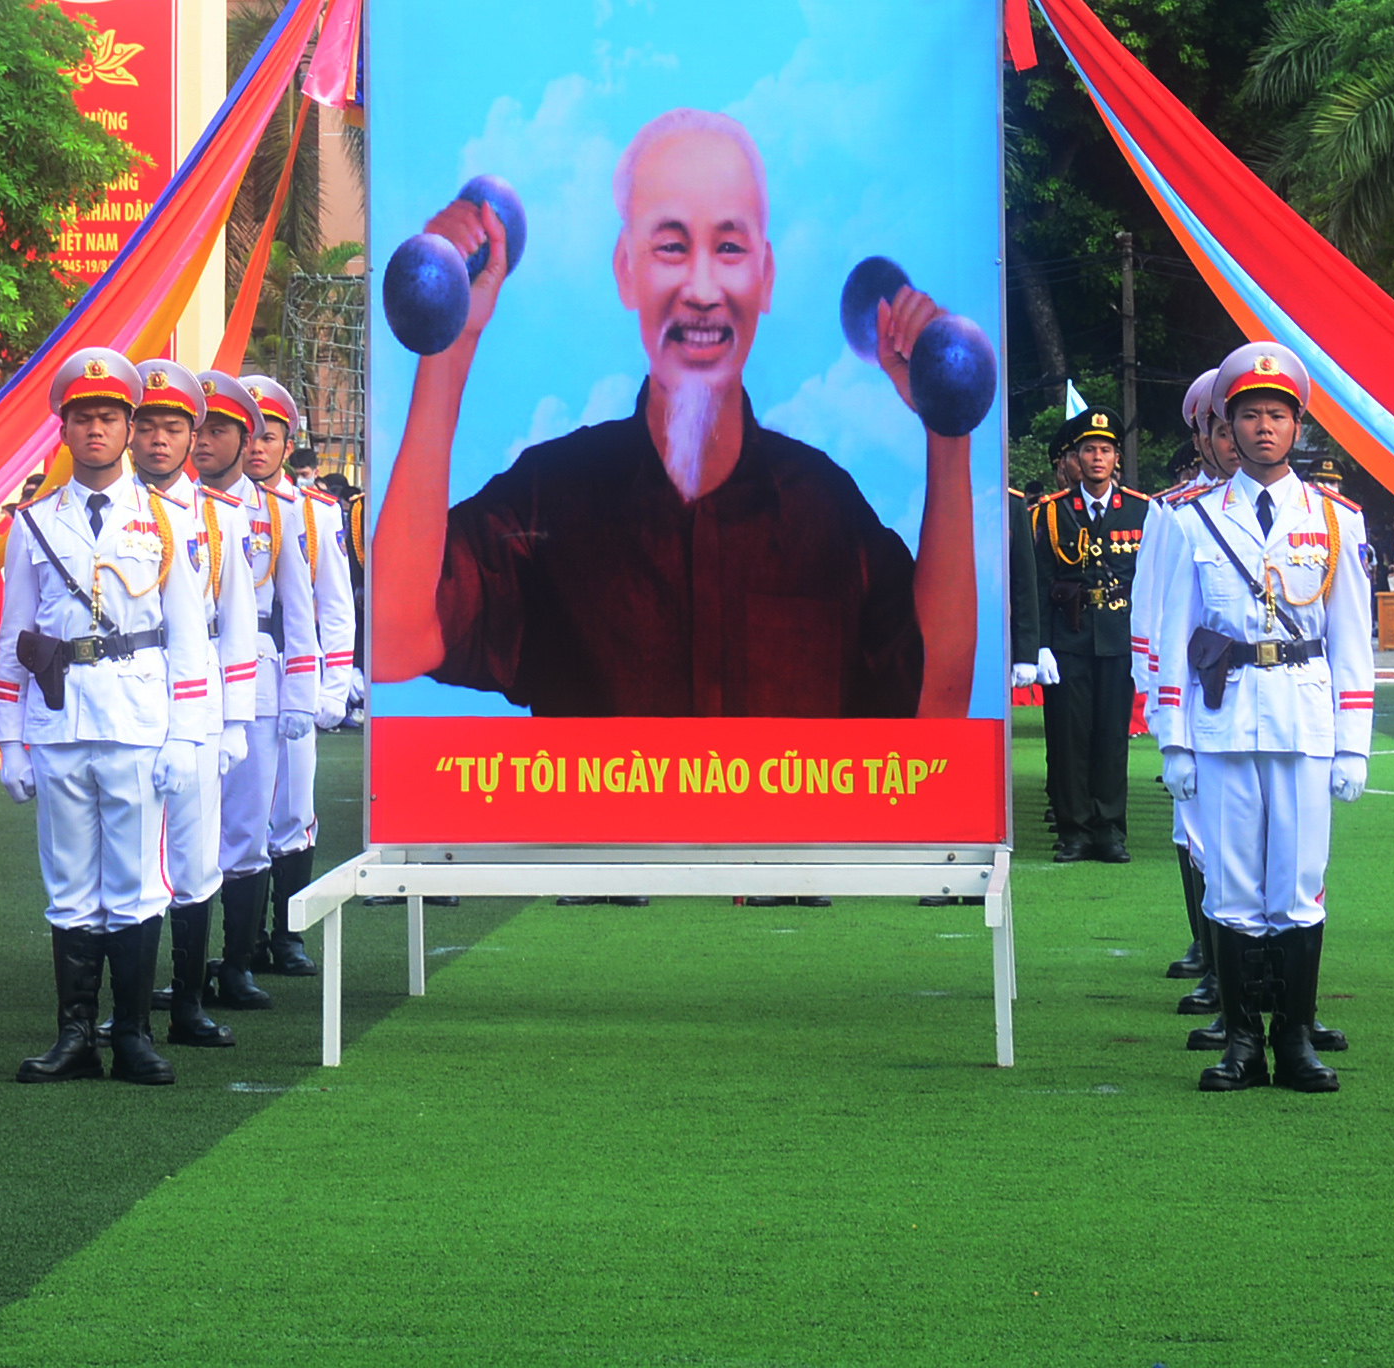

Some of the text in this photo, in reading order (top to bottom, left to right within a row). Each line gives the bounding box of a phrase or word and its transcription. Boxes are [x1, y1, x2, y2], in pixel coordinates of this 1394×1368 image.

[51, 228, 119, 257] IỆT NAM
[510, 749, 567, 793] TÔI
[578, 749, 671, 793] NGÀY
[678, 750, 750, 794] NÀO
[758, 749, 854, 795] CŨNG
